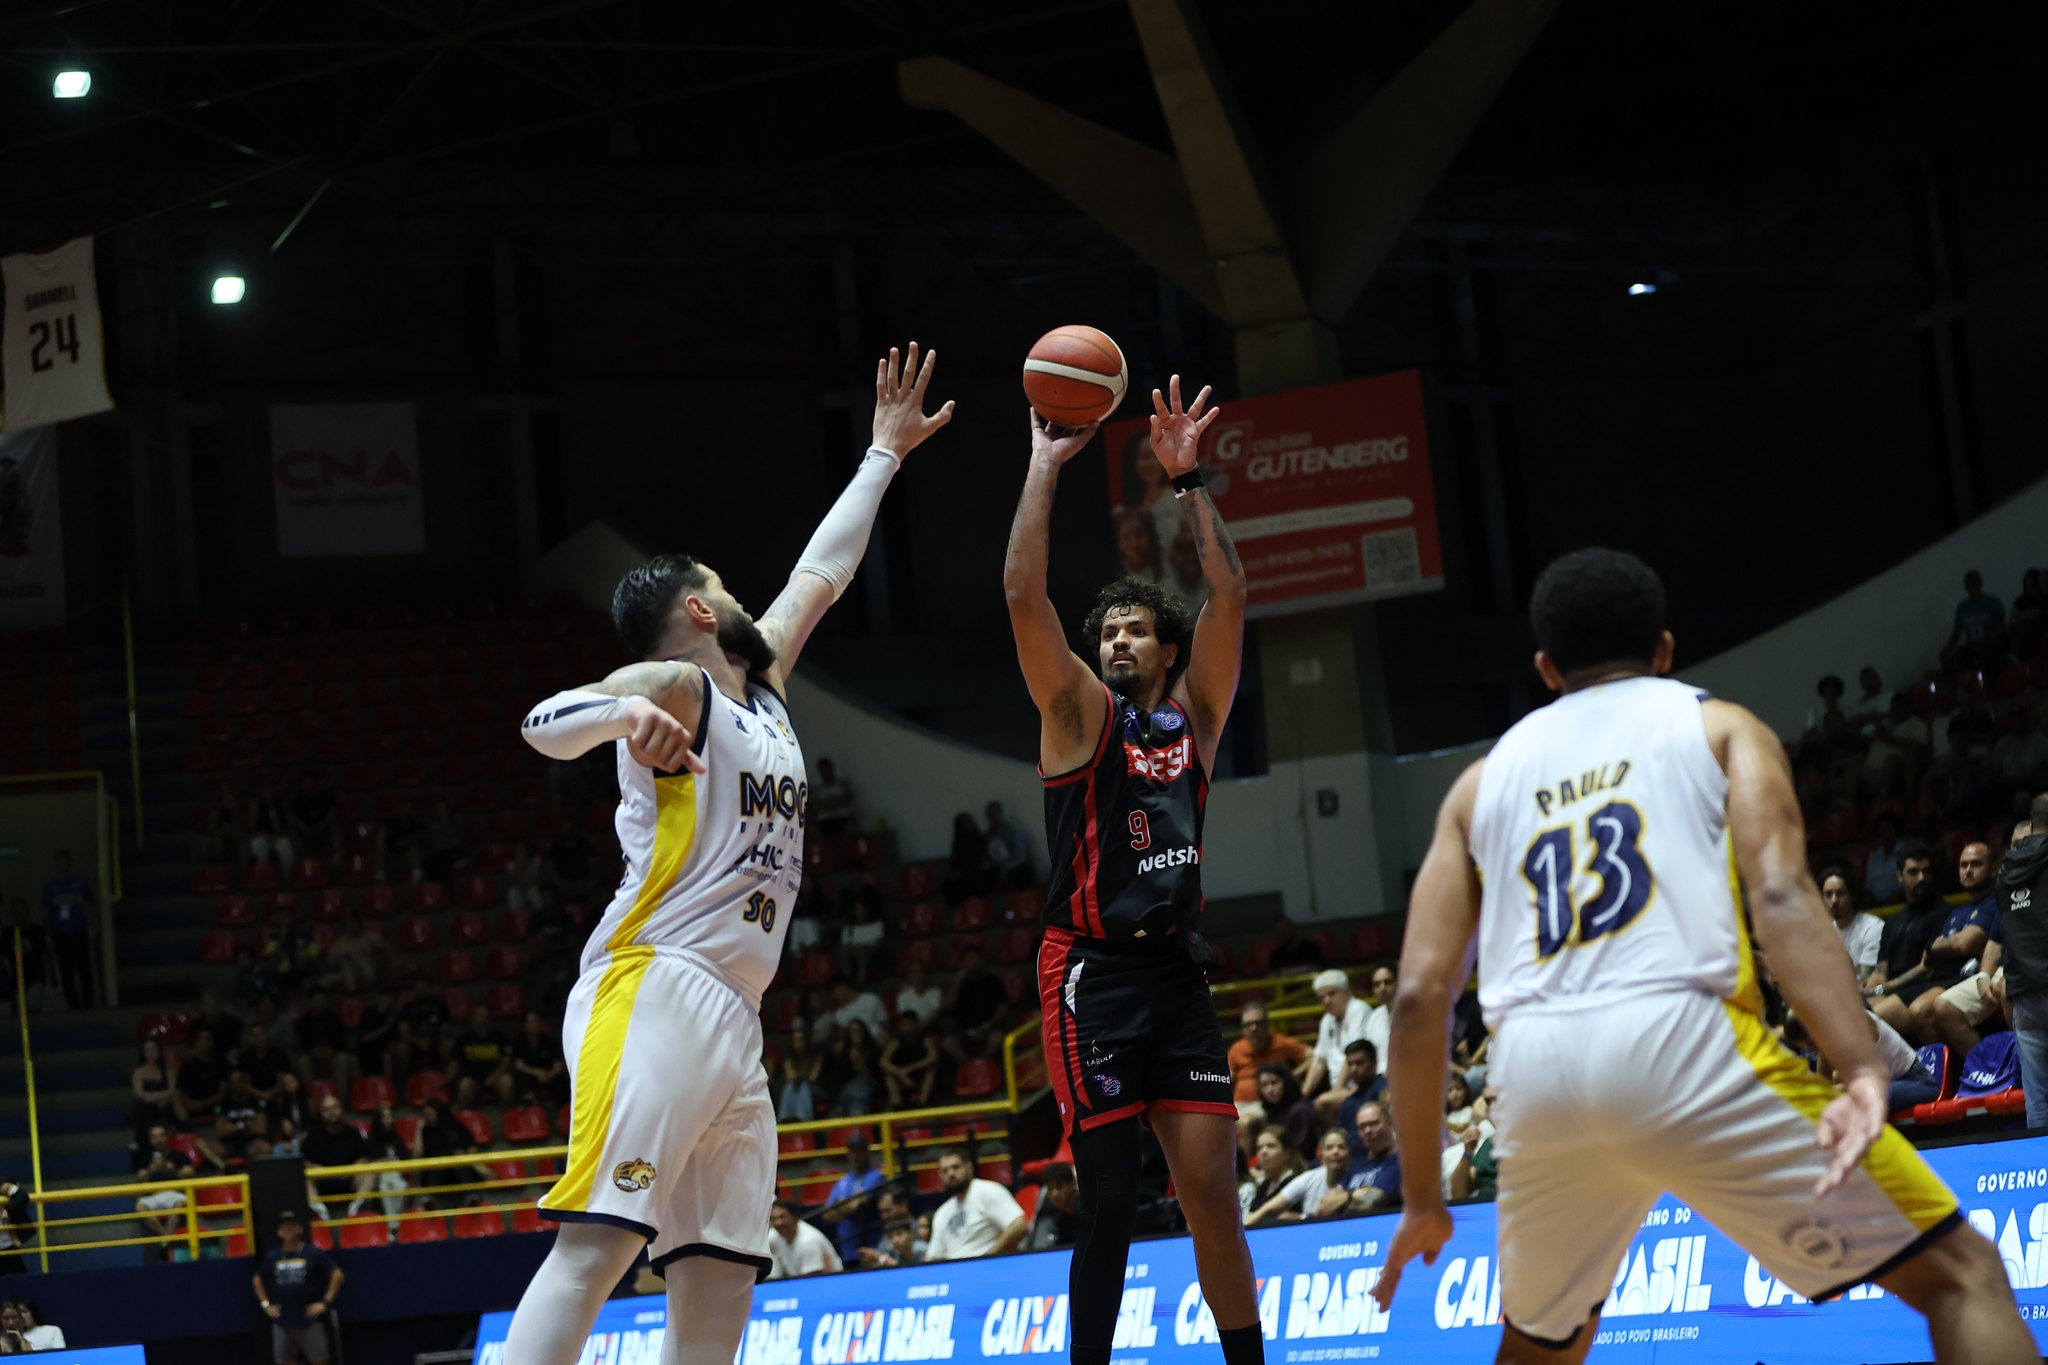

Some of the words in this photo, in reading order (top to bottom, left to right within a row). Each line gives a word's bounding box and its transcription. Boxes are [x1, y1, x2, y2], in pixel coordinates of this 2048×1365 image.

[29, 314, 80, 373] 24
[1216, 429, 1244, 461] G
[1246, 435, 1409, 483] GUTENBERG
[277, 449, 418, 489] CNA
[1131, 738, 1190, 781] SESI
[739, 770, 808, 828] MOG
[1128, 809, 1152, 851] 9
[1137, 845, 1199, 876] Netsh
[1519, 799, 1656, 963] 13
[742, 890, 776, 934] 50
[1977, 1168, 2048, 1194] GOVERNO
[1674, 1206, 1692, 1225] DO
[1318, 1244, 1361, 1262] GOVERNO
[1363, 1240, 1379, 1257] DO
[811, 1309, 885, 1365] CAIXA
[883, 1303, 956, 1362] BRASIL
[981, 1293, 1069, 1357] CAIXA
[1614, 1330, 1627, 1344] DO
[1628, 1328, 1651, 1343] POVO
[1652, 1325, 1699, 1342] BRASILEIRO
